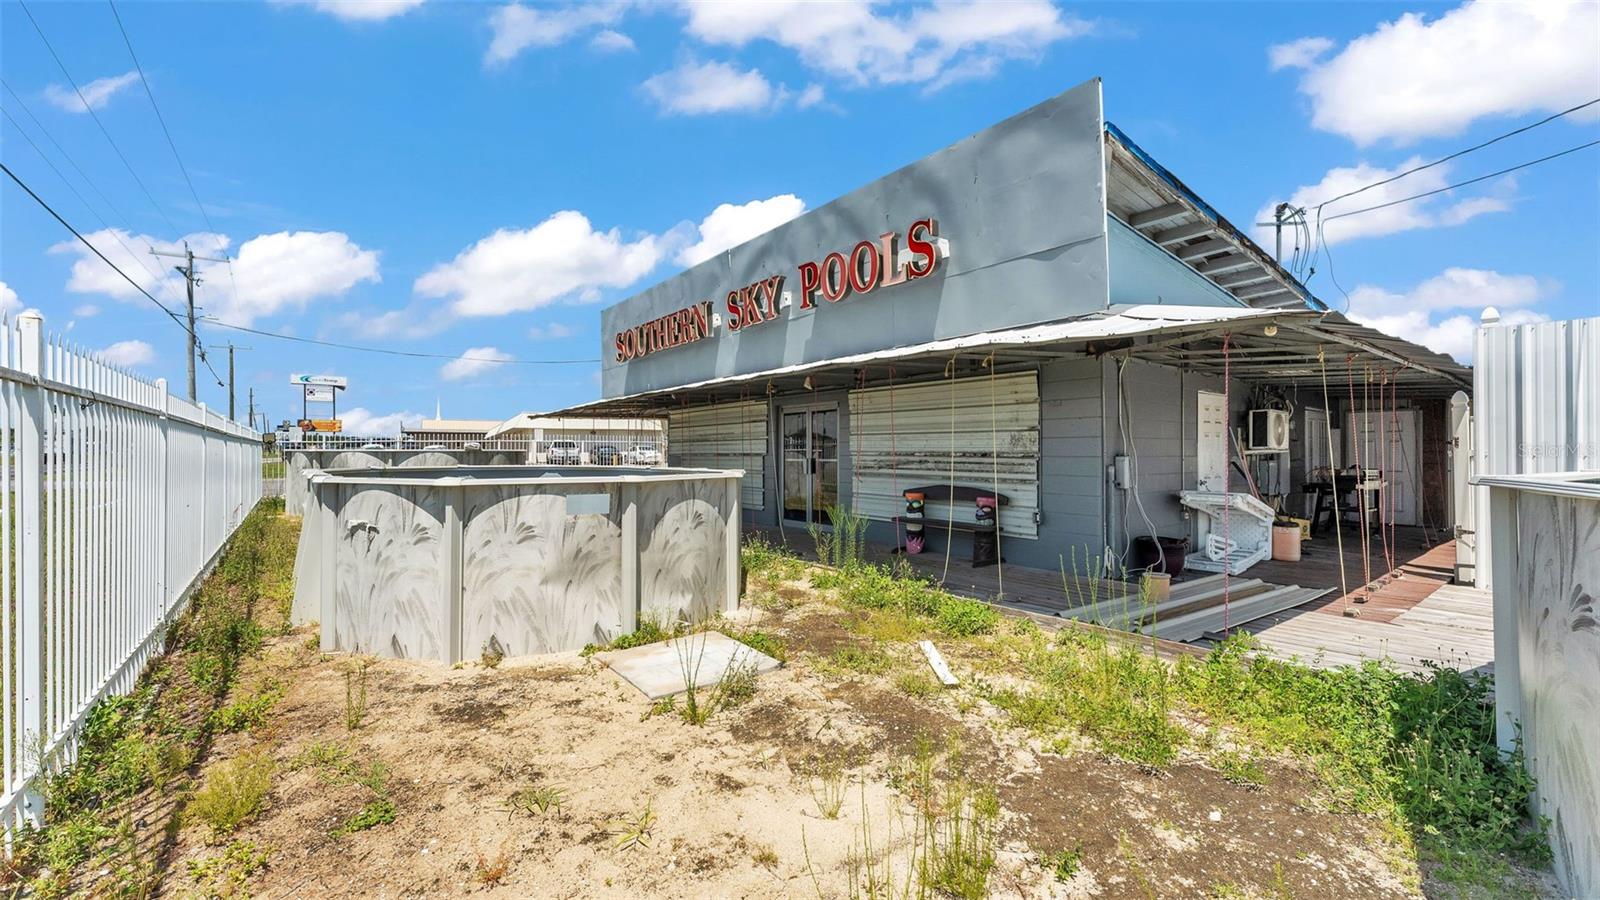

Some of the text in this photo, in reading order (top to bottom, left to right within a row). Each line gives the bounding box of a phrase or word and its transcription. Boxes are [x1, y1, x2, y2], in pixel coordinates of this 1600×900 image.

[614, 218, 938, 362] SOUTHERN SKY POOLS
